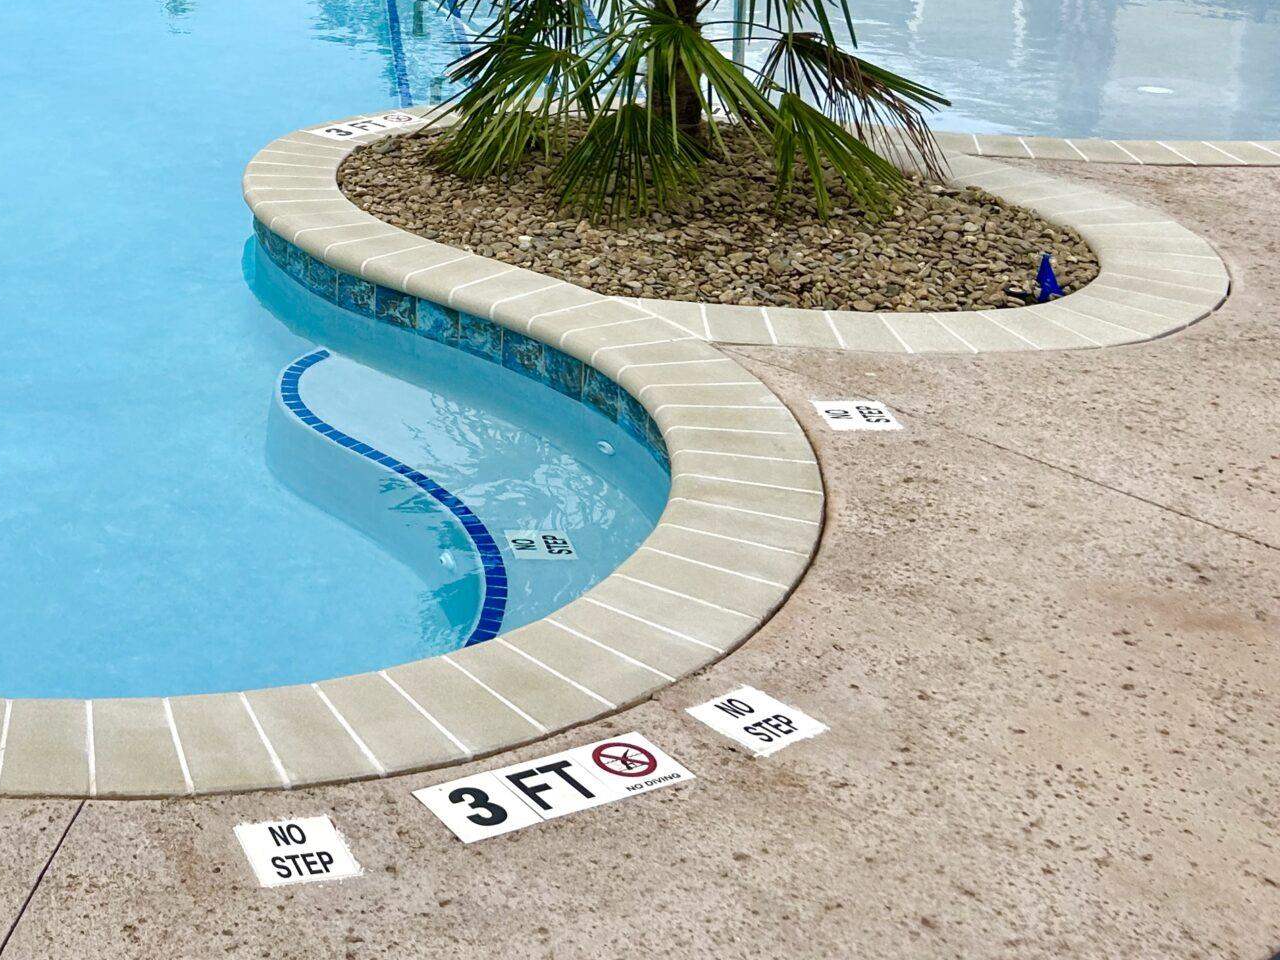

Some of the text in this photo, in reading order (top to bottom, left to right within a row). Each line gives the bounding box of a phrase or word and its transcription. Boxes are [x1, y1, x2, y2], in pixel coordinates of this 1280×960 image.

[325, 120, 387, 137] 3 FT
[824, 409, 854, 420] NO
[855, 405, 891, 423] STEP
[510, 538, 538, 551] NO
[541, 534, 573, 555] STEP
[713, 698, 755, 719] NO
[743, 714, 799, 743] STEP
[625, 772, 682, 792] NO DIVING
[448, 759, 597, 827] 3 FT
[267, 823, 307, 847] NO
[270, 851, 334, 879] STEP
